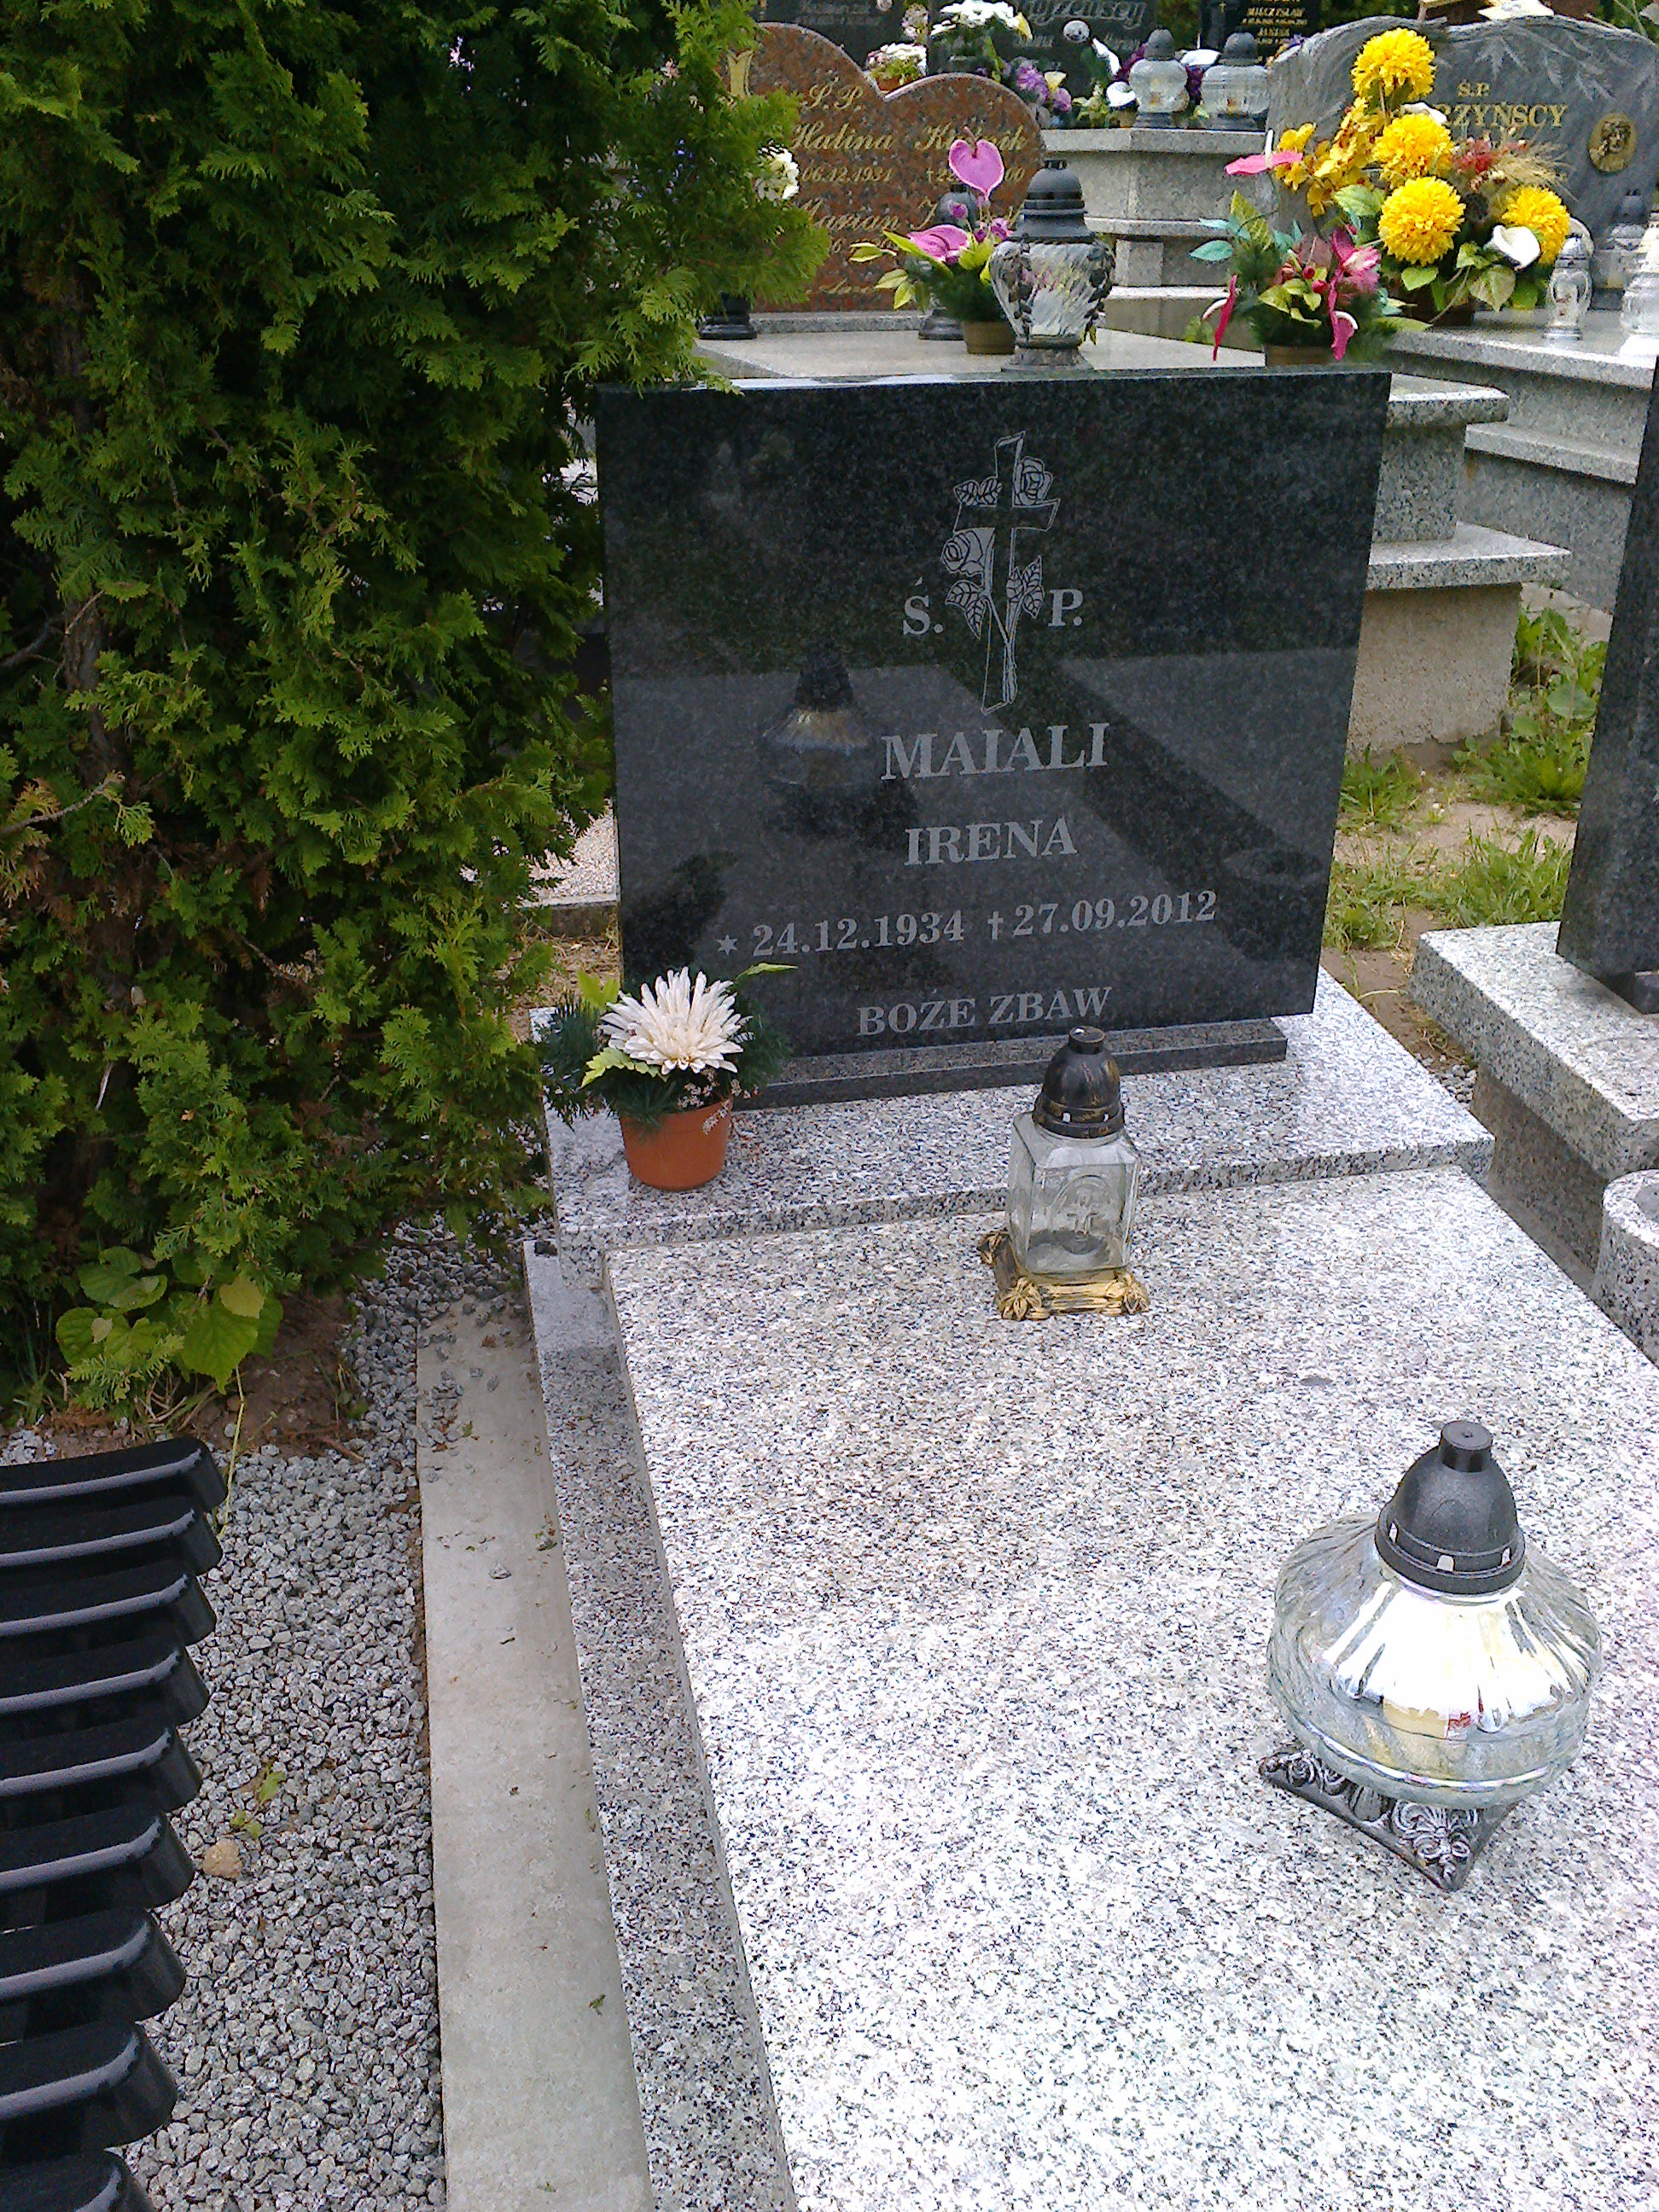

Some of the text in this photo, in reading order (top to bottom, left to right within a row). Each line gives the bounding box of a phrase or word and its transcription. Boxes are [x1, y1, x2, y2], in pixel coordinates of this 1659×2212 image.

[790, 120, 893, 150] Halina
[1047, 588, 1084, 627] P.
[880, 722, 1109, 781] MAIALI
[904, 816, 1079, 865] IRENA
[753, 890, 1217, 957] 24.12.1934 27.09.2012
[988, 987, 1112, 1024] ZBAW
